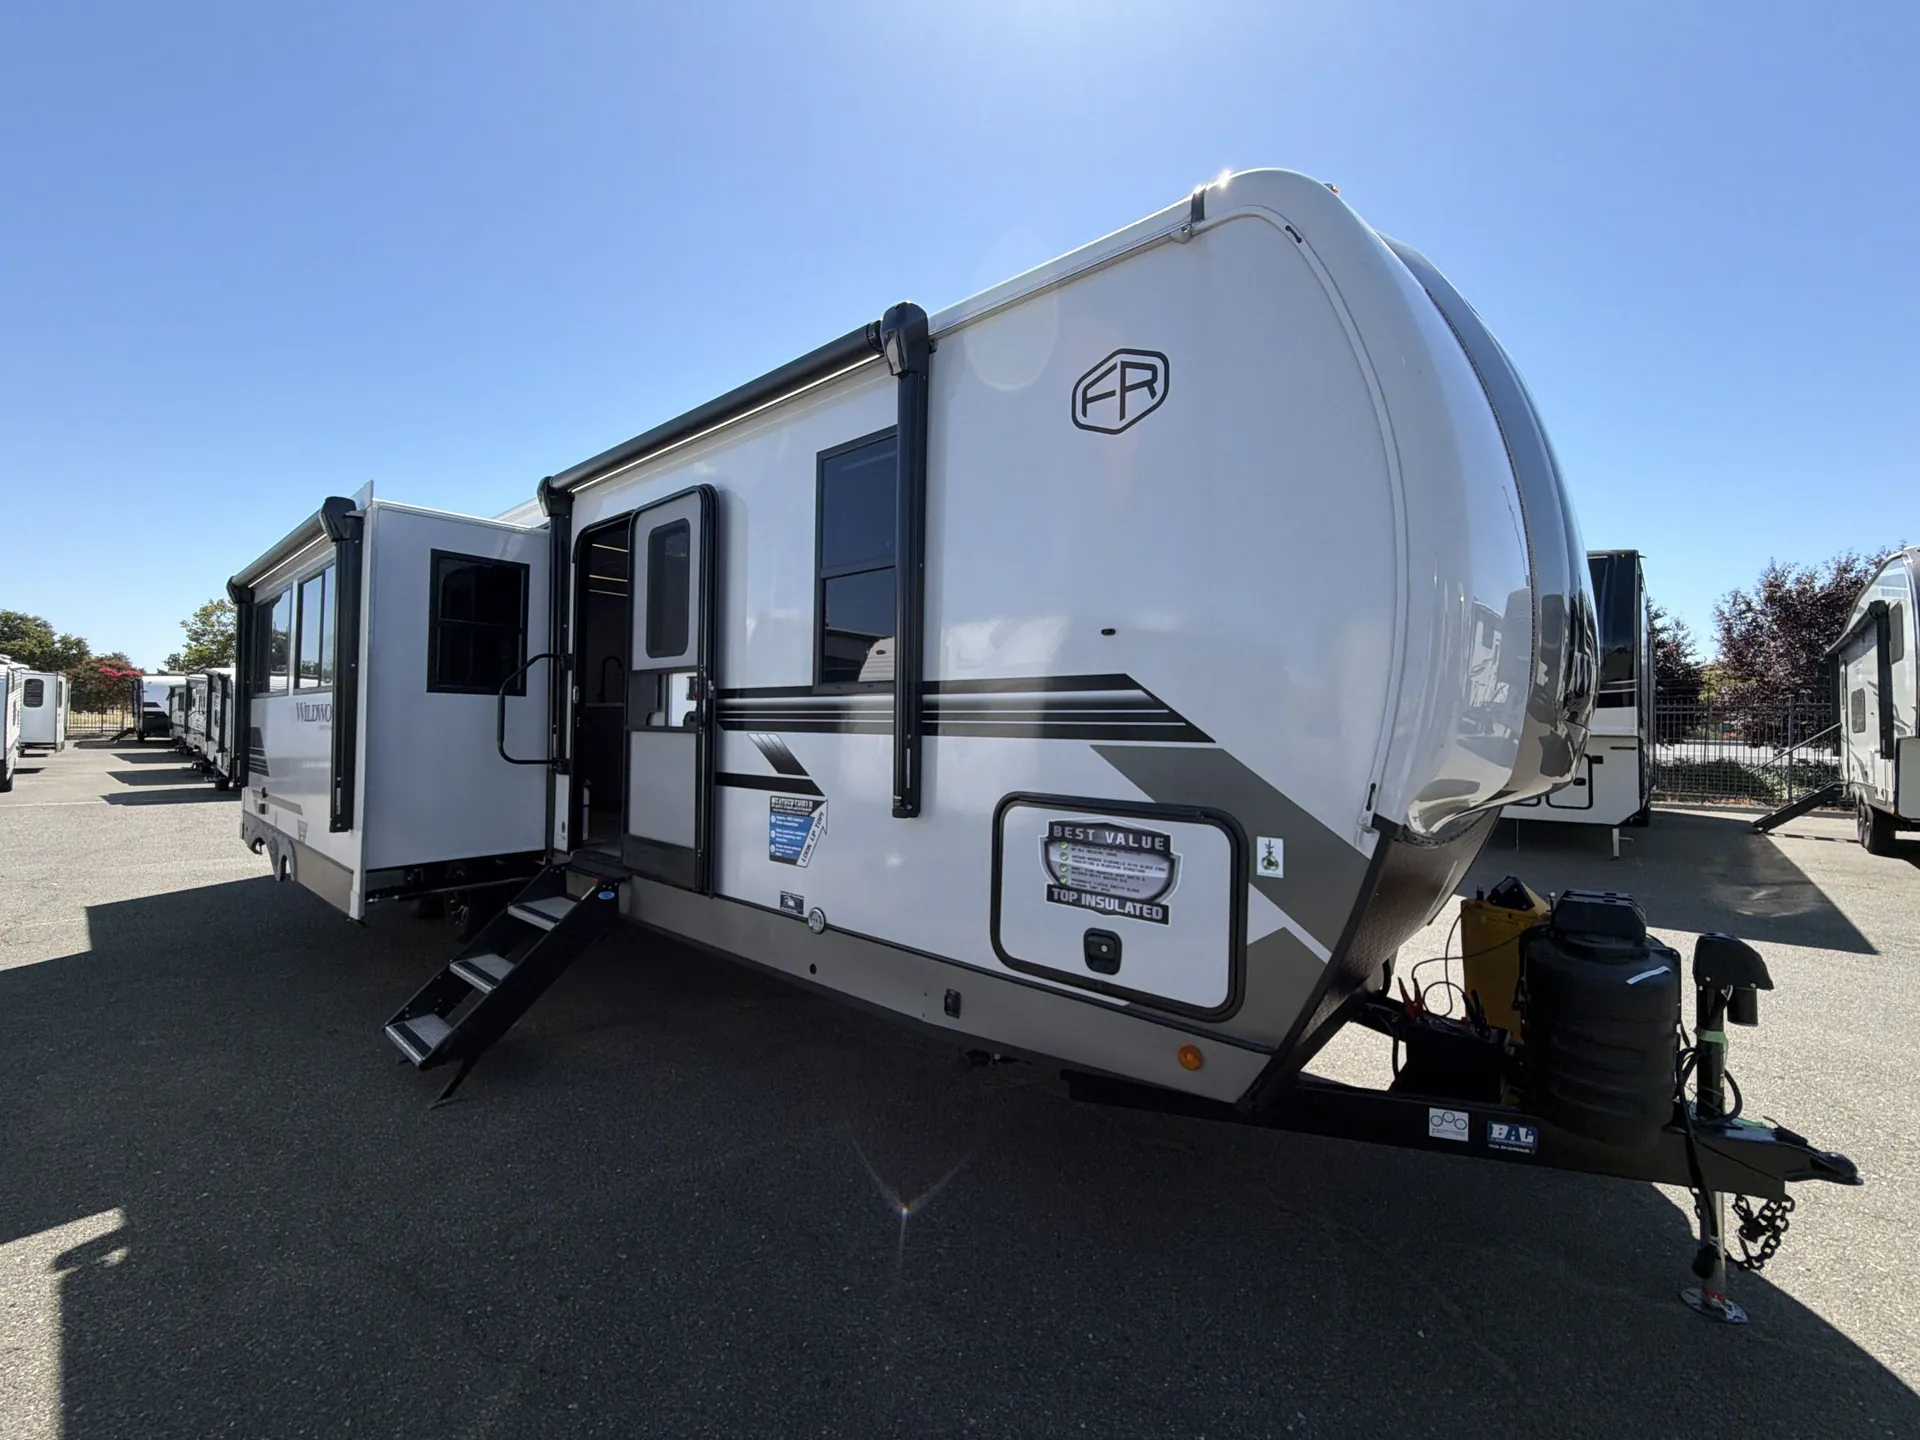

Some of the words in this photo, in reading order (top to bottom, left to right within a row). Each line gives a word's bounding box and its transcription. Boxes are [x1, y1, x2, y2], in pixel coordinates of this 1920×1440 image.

[1082, 359, 1158, 422] FR
[296, 701, 332, 722] WILDWO
[801, 844, 812, 863] LOOK
[810, 830, 817, 842] UP
[1053, 824, 1096, 841] BEST
[1104, 831, 1165, 851] VALUE
[1052, 888, 1078, 903] TOP
[1081, 893, 1163, 920] INSULATED
[1491, 1123, 1534, 1143] BAL
